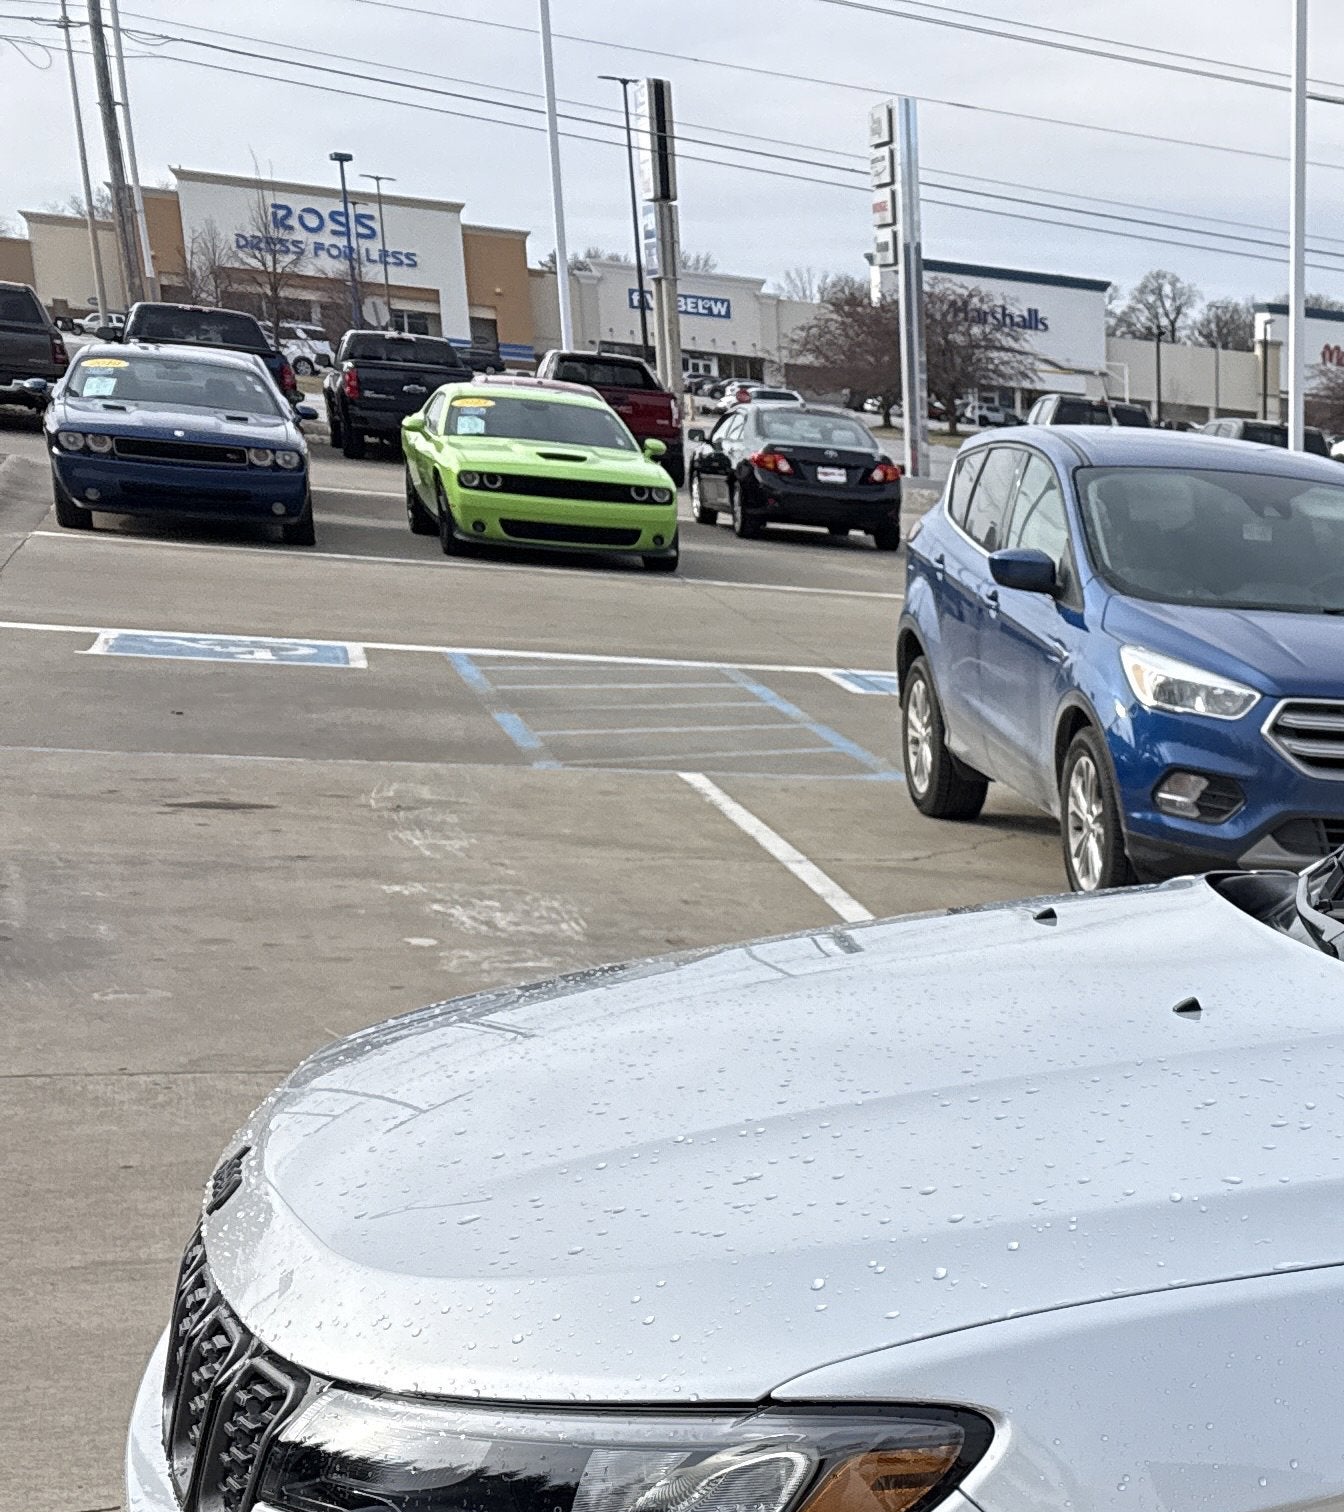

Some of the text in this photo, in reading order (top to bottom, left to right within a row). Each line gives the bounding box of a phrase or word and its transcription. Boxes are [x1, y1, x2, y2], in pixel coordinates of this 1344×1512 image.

[271, 203, 377, 240] ROSS
[234, 233, 418, 268] DRESS FOR LESS
